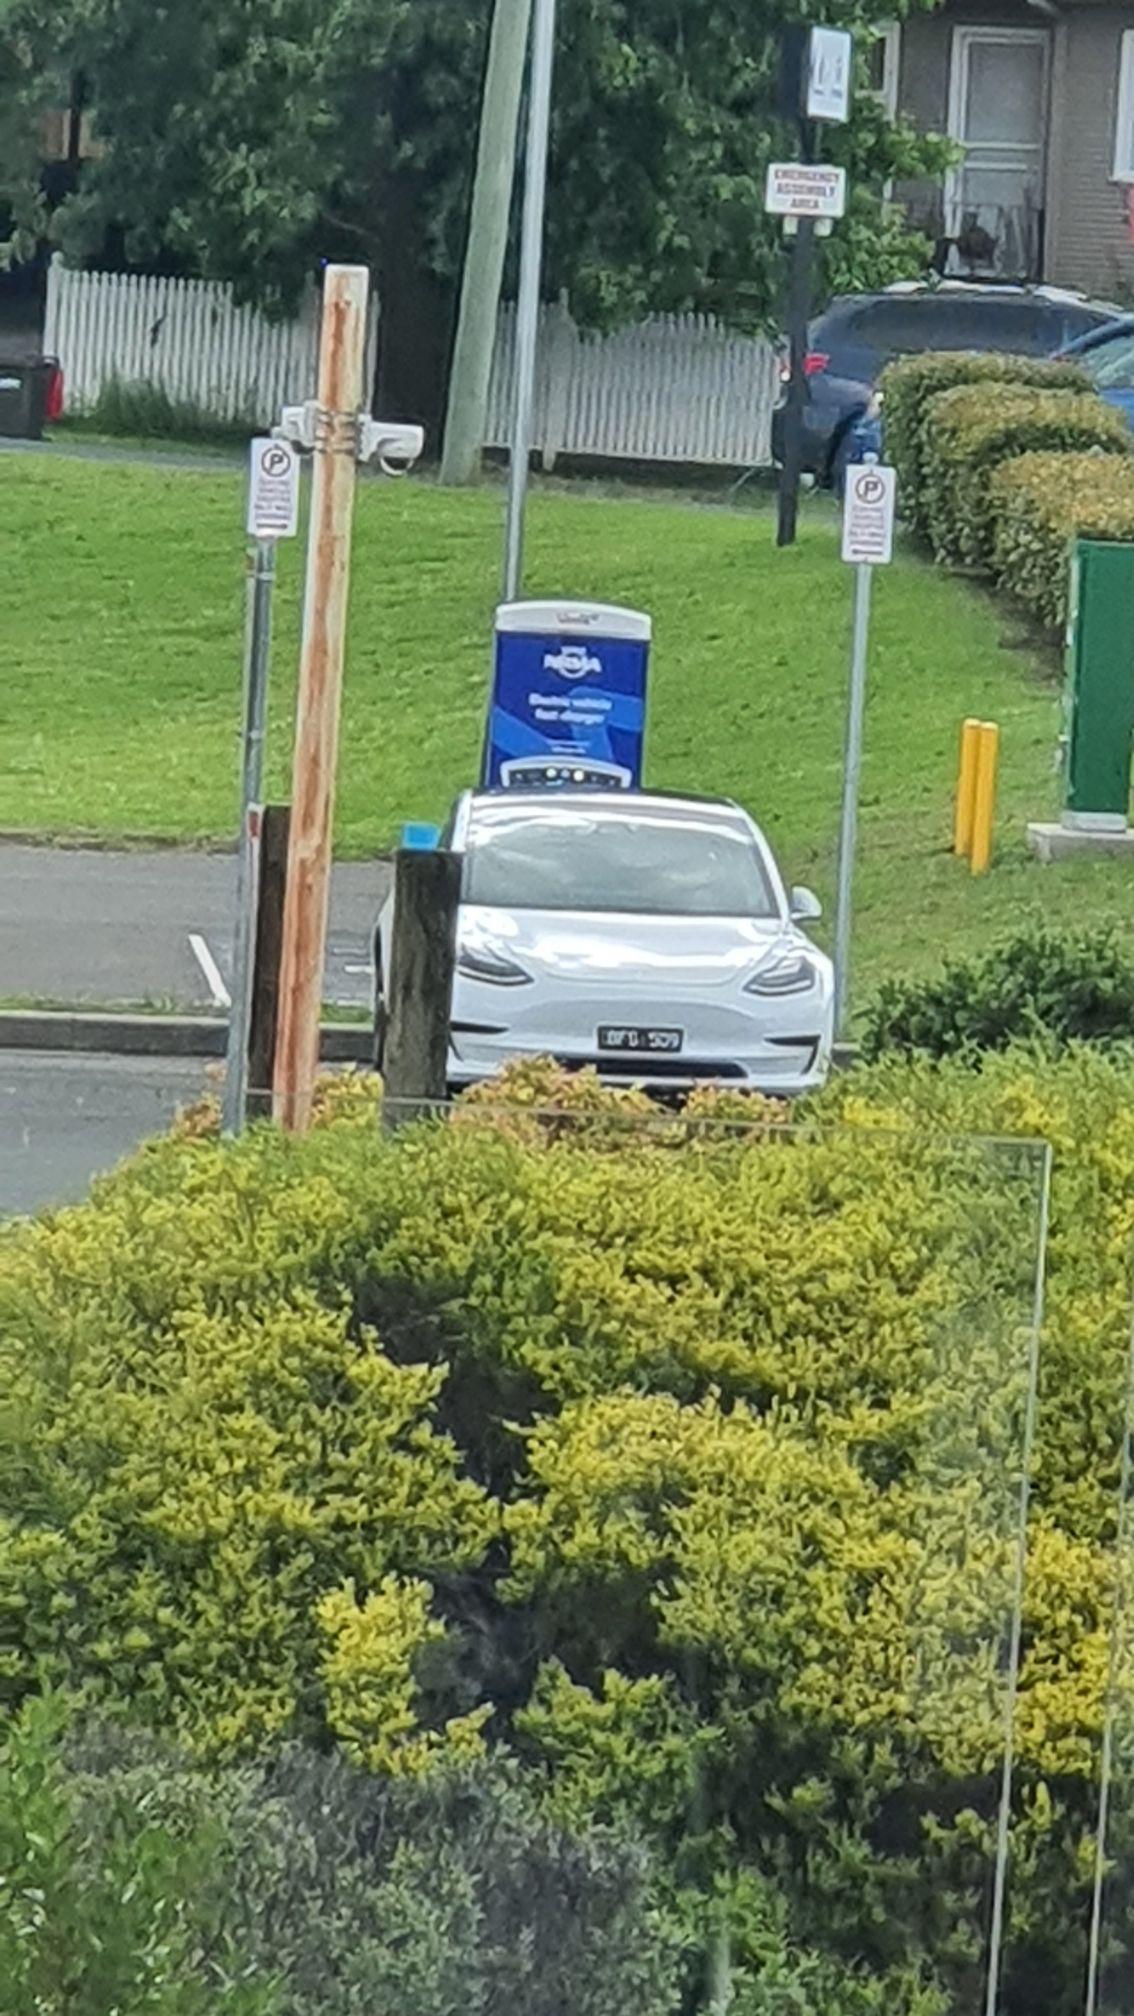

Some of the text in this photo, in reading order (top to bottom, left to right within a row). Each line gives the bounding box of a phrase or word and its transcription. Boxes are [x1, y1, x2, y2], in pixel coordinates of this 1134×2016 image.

[774, 169, 839, 182] EMERGENCY
[777, 183, 835, 197] ASSEMBLY
[791, 198, 819, 209] AREA
